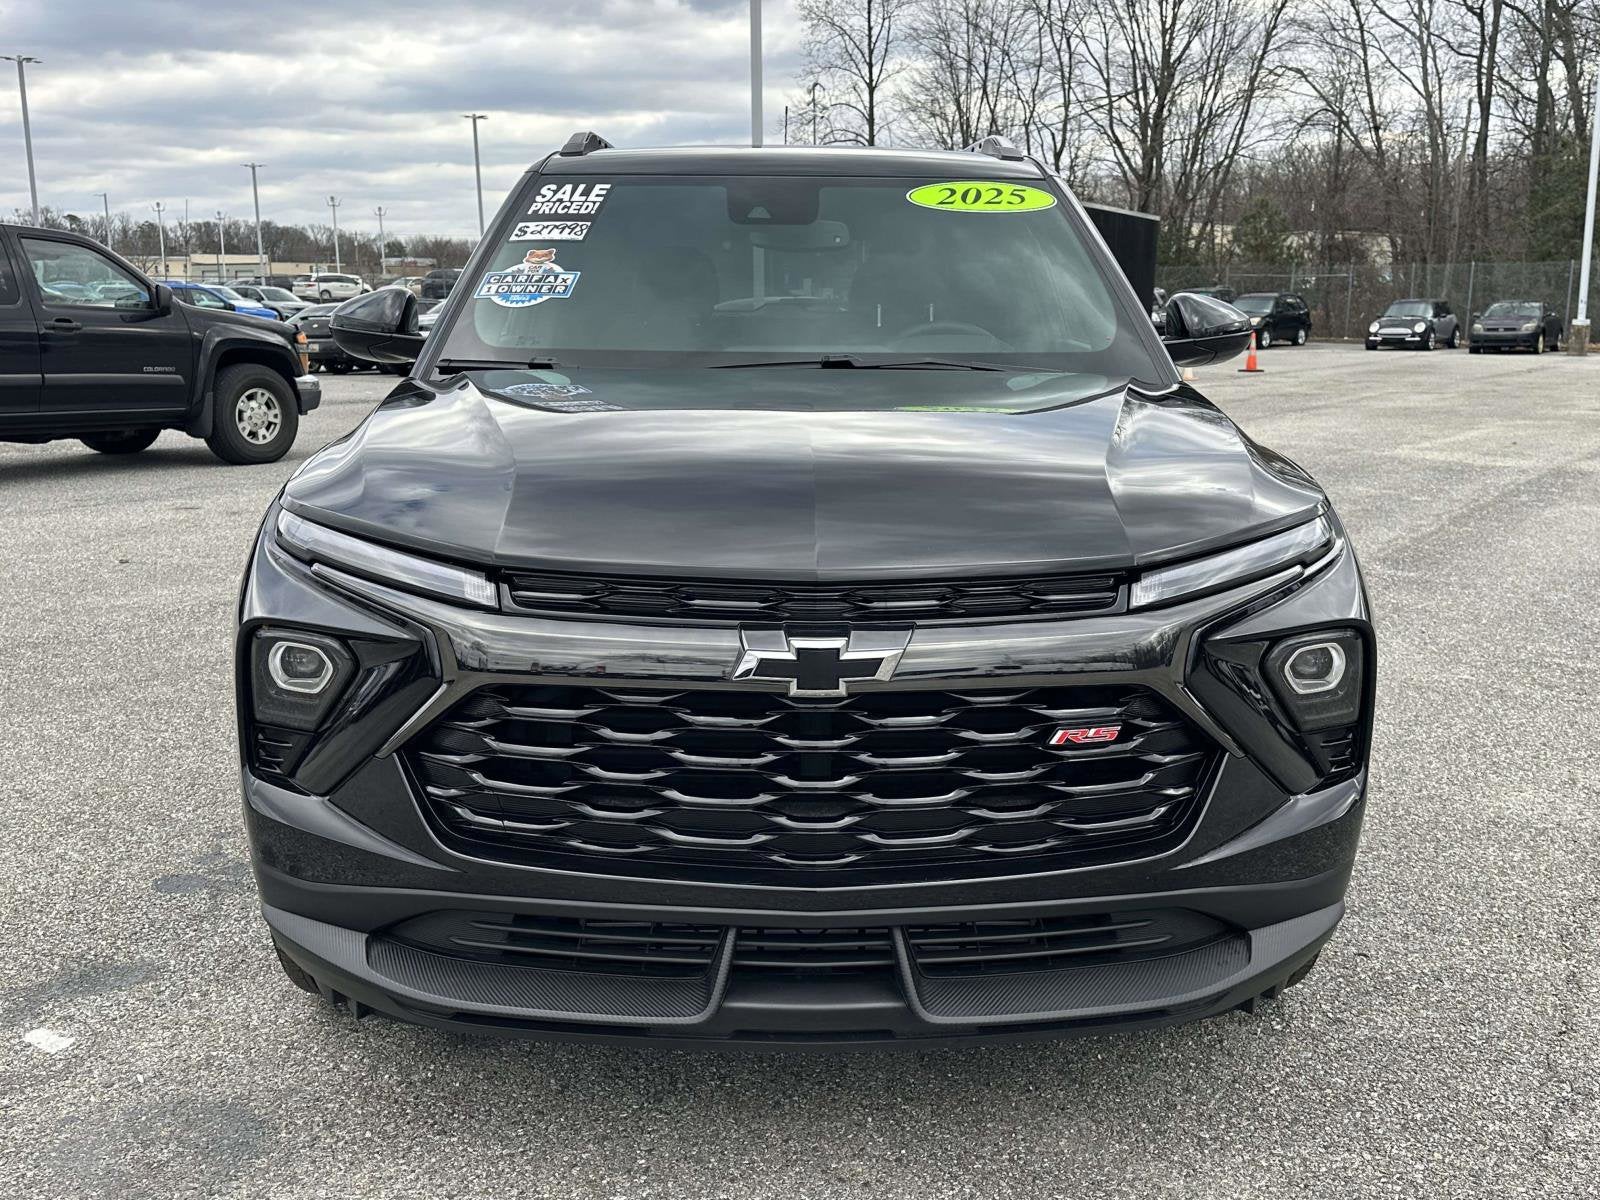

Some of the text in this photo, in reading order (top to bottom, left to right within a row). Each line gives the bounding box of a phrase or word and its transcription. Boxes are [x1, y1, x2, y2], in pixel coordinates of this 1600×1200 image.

[535, 184, 611, 202] SALE
[936, 187, 1027, 205] 2025
[527, 202, 600, 214] PRICED!
[514, 222, 589, 238] $27998
[489, 274, 570, 284] CARFAX
[498, 284, 566, 294] OWNER
[1049, 726, 1121, 744] RS
